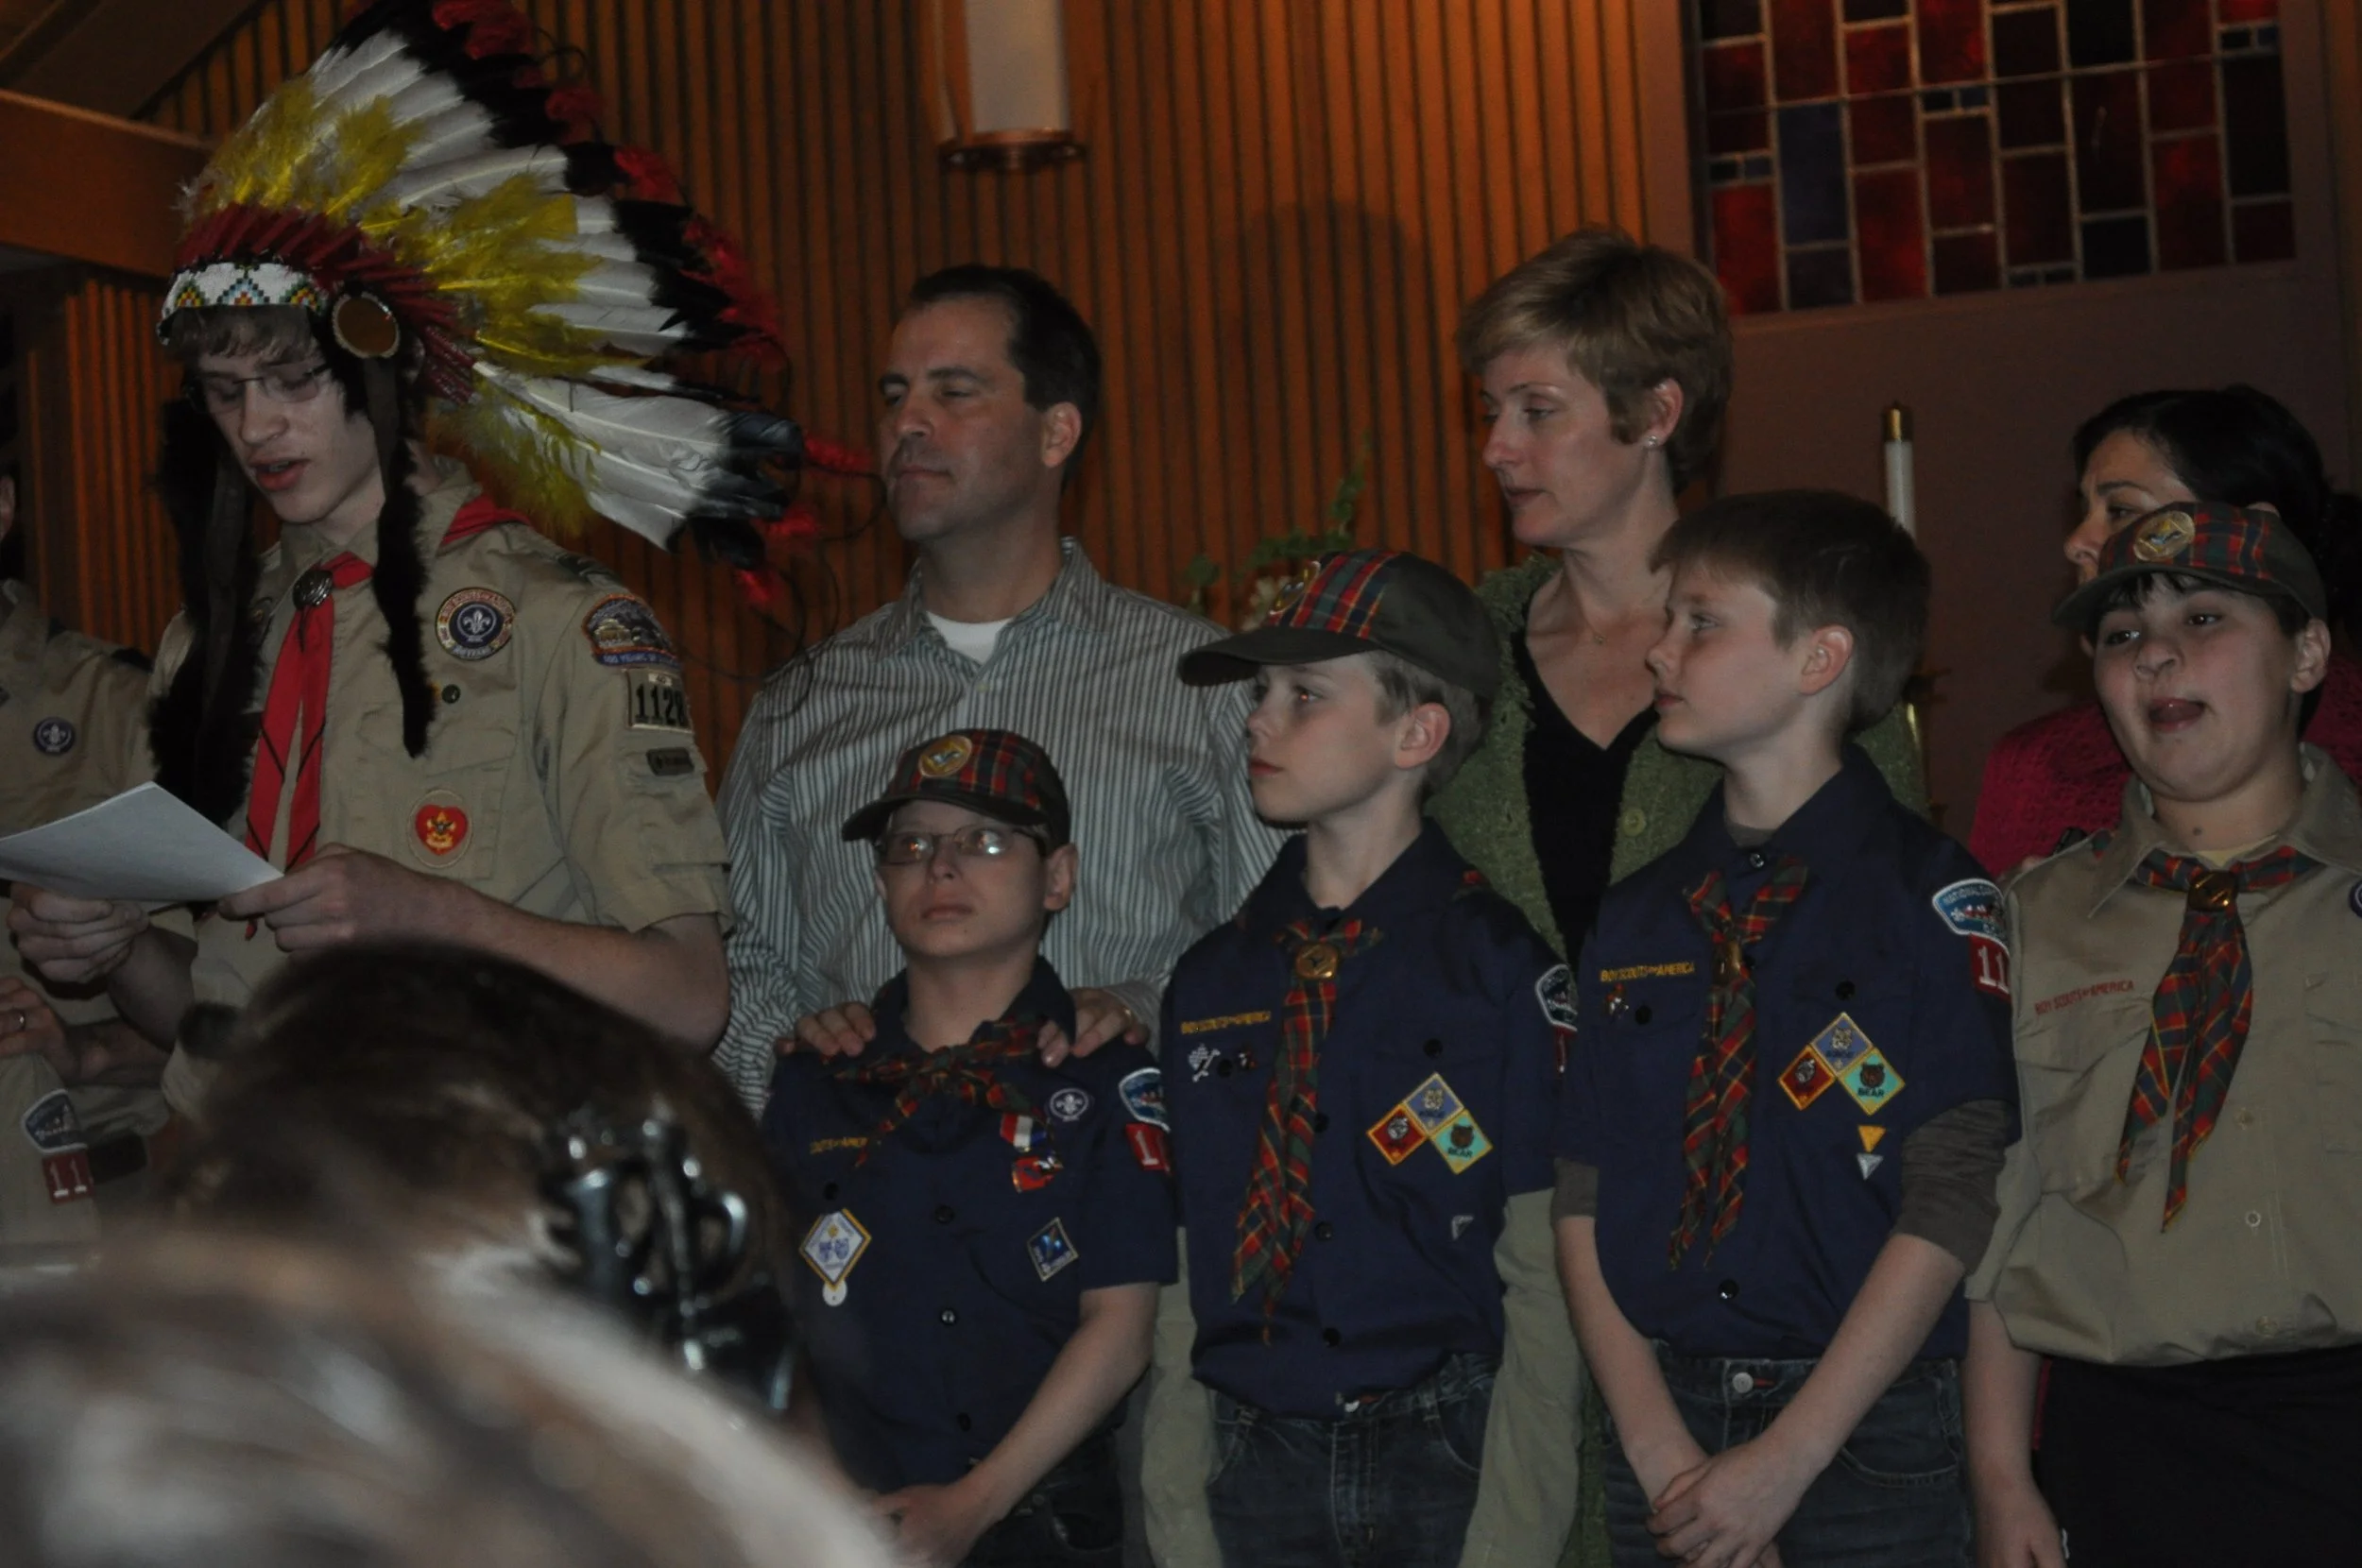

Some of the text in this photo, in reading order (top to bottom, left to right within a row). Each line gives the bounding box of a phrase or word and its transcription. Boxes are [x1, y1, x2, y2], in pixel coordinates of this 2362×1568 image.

[2090, 980, 2134, 997] AMERICA
[1858, 1087, 1885, 1097] BEAR
[1447, 1147, 1473, 1158] BEAR
